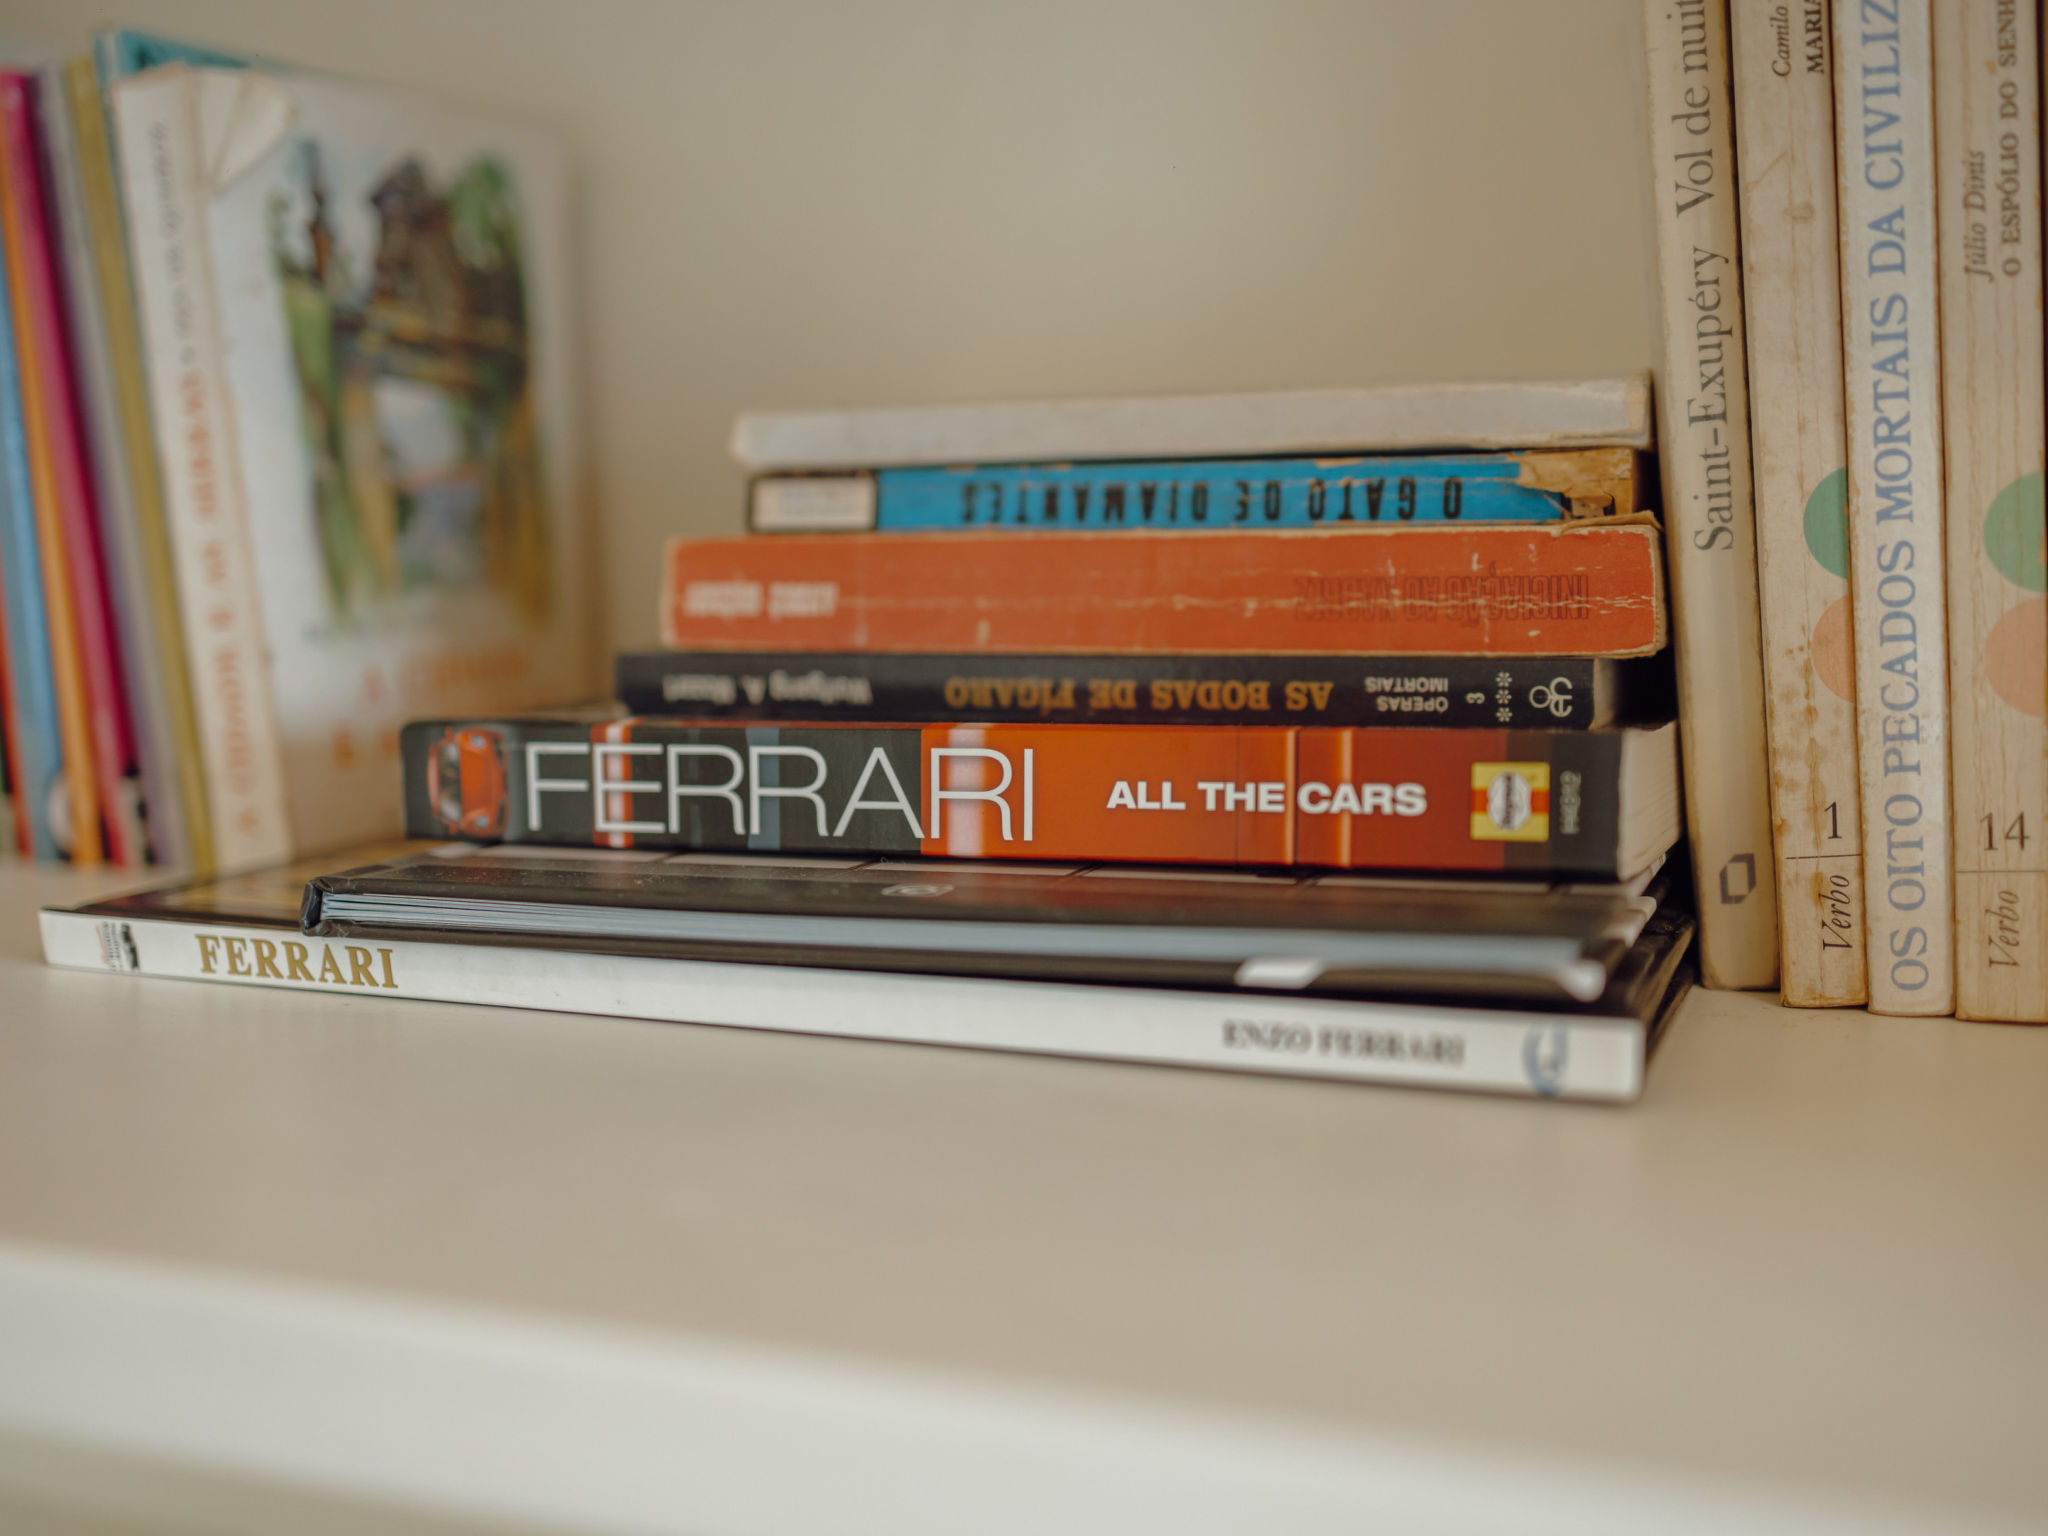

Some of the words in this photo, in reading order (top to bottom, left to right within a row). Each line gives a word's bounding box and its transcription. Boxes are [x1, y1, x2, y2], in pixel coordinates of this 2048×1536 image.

[1769, 5, 1793, 77] Camilo
[1671, 86, 1712, 136] de
[1861, 0, 1905, 190] CIVILIZ
[2000, 80, 2020, 120] DO
[1674, 148, 1714, 218] Vol
[1996, 132, 2020, 246] ESPÓLIO
[1867, 205, 1907, 278] DA
[1964, 213, 1994, 281] Júlio
[2000, 256, 2021, 277] O
[1688, 246, 1734, 552] Saint-Exupéry
[1870, 292, 1914, 526] MORTAIS
[962, 480, 1209, 524] DIAMANTES
[1235, 480, 1283, 522] DE
[1308, 477, 1416, 521] GATO
[1442, 477, 1463, 519] O
[1877, 540, 1922, 778] PECADOS
[1089, 679, 1138, 711] DE
[1150, 680, 1271, 711] BODAS
[1285, 680, 1333, 711] AS
[1364, 676, 1449, 693] IMORTAIS
[1377, 695, 1449, 713] ÓPERAS
[526, 741, 1034, 841] FERRARI
[1107, 780, 1186, 810] ALL
[1197, 781, 1286, 813] THE
[1297, 781, 1427, 817] CARS
[1824, 801, 1844, 840] 1
[1980, 811, 2031, 852] 14
[1884, 793, 1927, 912] OITO
[1818, 873, 1854, 952] Verbo
[1985, 889, 2021, 970] Verbo
[195, 933, 400, 990] FERRARI
[1890, 926, 1929, 991] OS
[1222, 1018, 1311, 1057] ENZO
[1317, 1022, 1467, 1068] FERRARI
